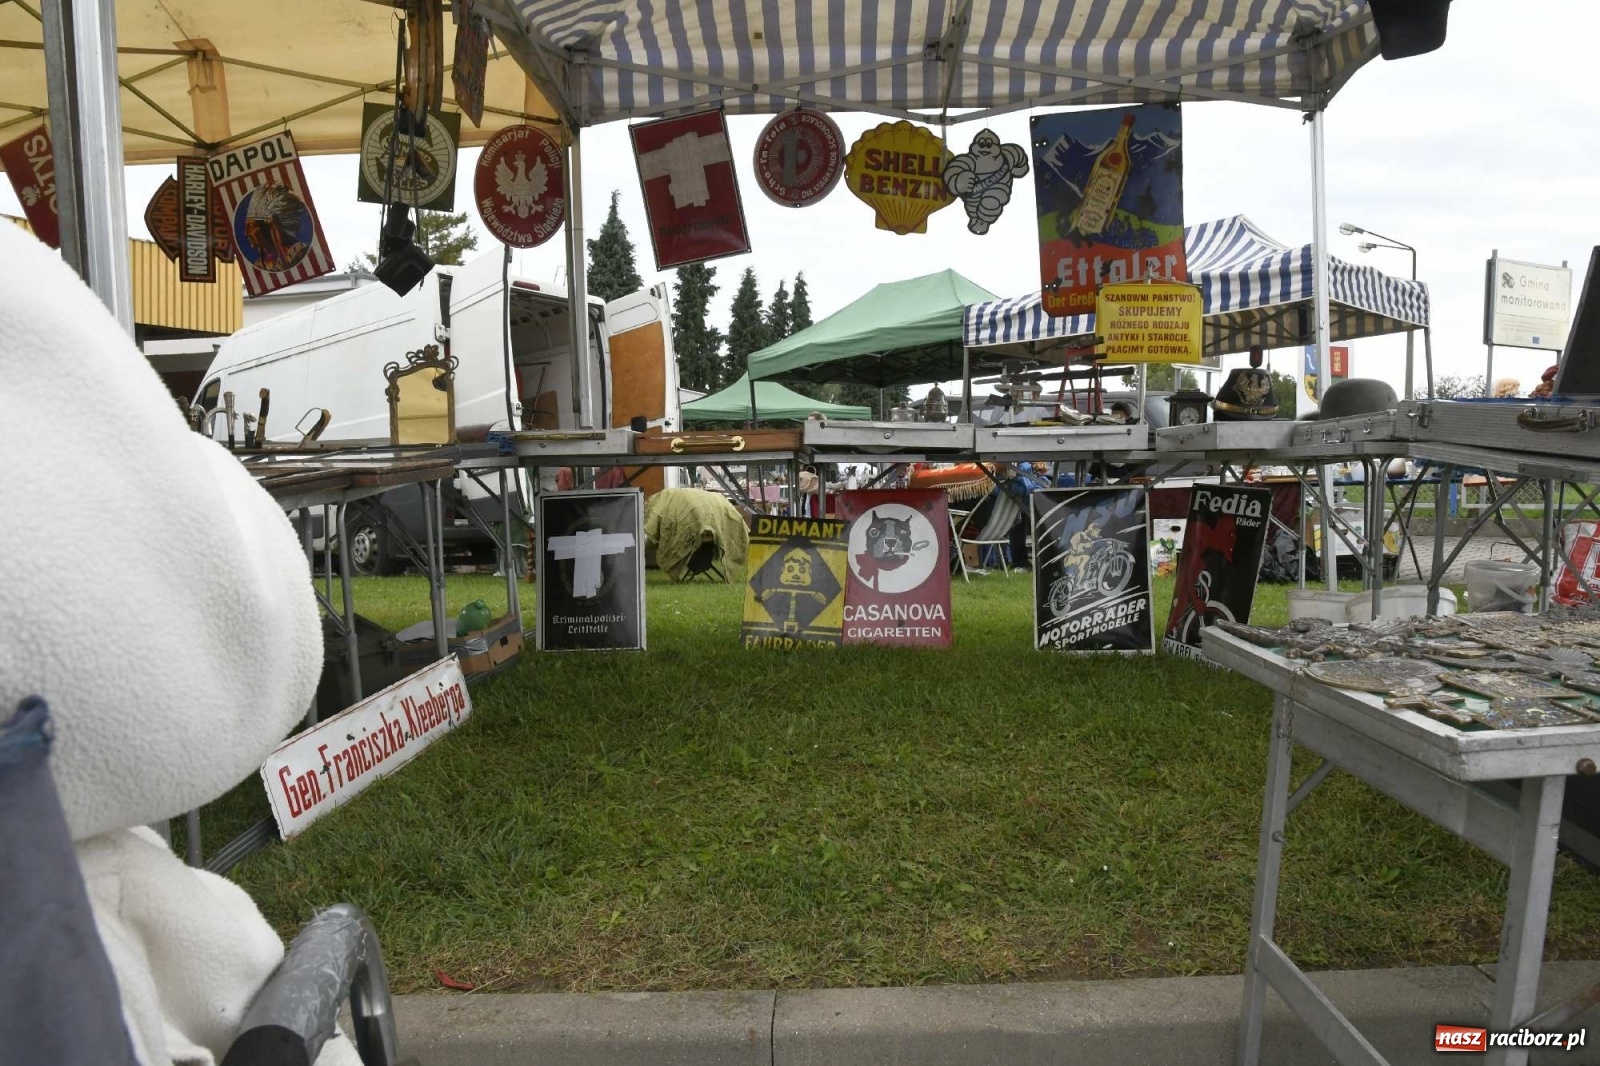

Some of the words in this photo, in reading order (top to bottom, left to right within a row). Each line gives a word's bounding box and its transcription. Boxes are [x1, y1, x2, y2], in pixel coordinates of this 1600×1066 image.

[801, 114, 837, 149] SCHOKOLADE
[210, 136, 293, 183] DAPOL
[480, 128, 530, 168] Komisarjat
[539, 138, 561, 169] Policji
[864, 148, 945, 179] SHELL
[801, 189, 814, 199] DIE
[859, 173, 949, 202] BENZIN
[152, 187, 177, 250] COMPANY
[184, 164, 208, 275] HARLEY-DAVIDSON
[480, 196, 533, 244] Województwa
[533, 197, 564, 239] Śląskiego
[1057, 251, 1178, 288] Ettaler
[1519, 275, 1550, 291] Gmina
[1048, 295, 1066, 308] Der
[1104, 293, 1149, 303] SZANOWNI
[1152, 291, 1196, 303] PAŃSTWO!
[1500, 294, 1566, 311] monitorowana
[1118, 306, 1183, 317] SKUPUJEMY
[1109, 318, 1150, 330] RÓŻNEGO
[1152, 320, 1190, 331] RODZAJU
[1106, 345, 1144, 354] PŁACIMY
[1147, 344, 1192, 356] GOTÓWKĄ.
[1107, 333, 1139, 342] ANTYKI
[1141, 333, 1146, 342] I
[1147, 333, 1192, 343] STAROCIE.
[1192, 490, 1262, 518] Fedia
[757, 518, 845, 539] DIAMANT
[1235, 516, 1262, 529] Räder
[843, 603, 946, 622] CASANOVA
[1038, 599, 1147, 648] MOTORRÄDER
[847, 626, 942, 638] CIGARETTEN
[1053, 612, 1141, 650] SPORTMODELLE
[317, 711, 405, 794] Franciszka
[400, 682, 465, 742] Kleeberga
